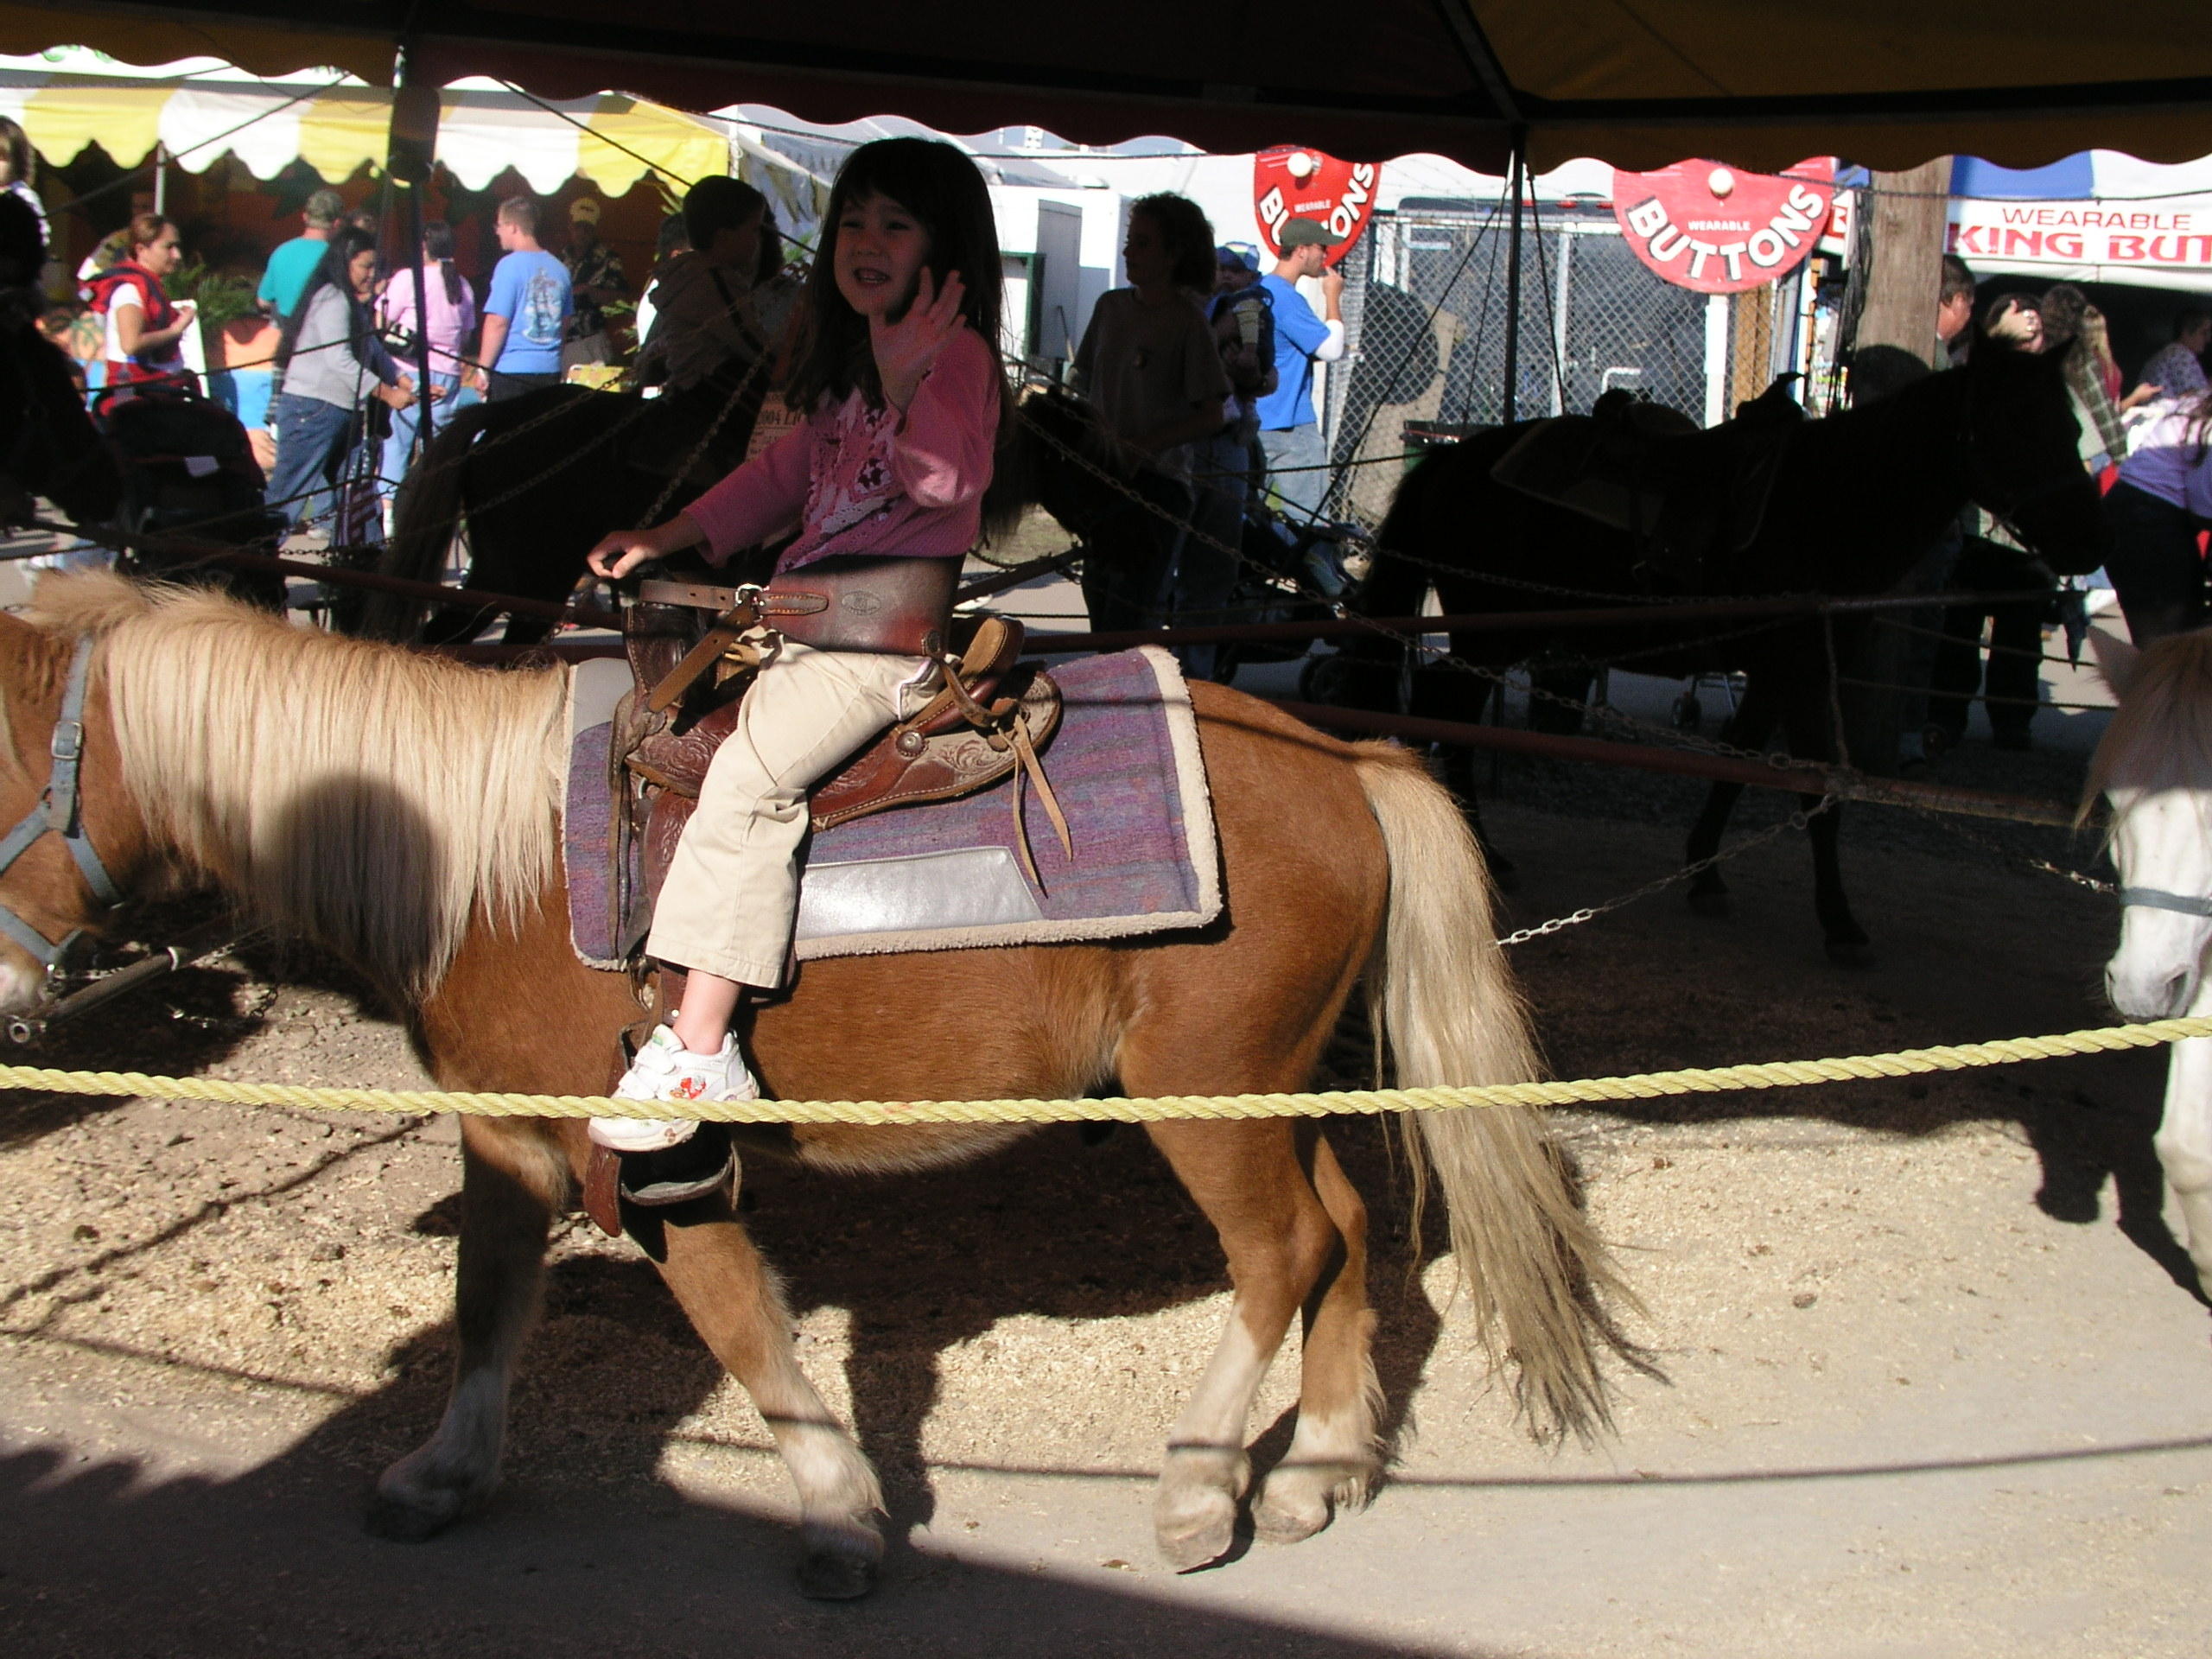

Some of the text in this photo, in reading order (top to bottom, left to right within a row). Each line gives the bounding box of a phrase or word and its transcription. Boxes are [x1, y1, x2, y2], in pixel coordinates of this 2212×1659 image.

[1294, 198, 1332, 213] WEARABLE
[1688, 219, 1751, 232] WEARABLE
[2002, 207, 2192, 232] WEARABLE
[1625, 184, 1823, 281] BUTTONS
